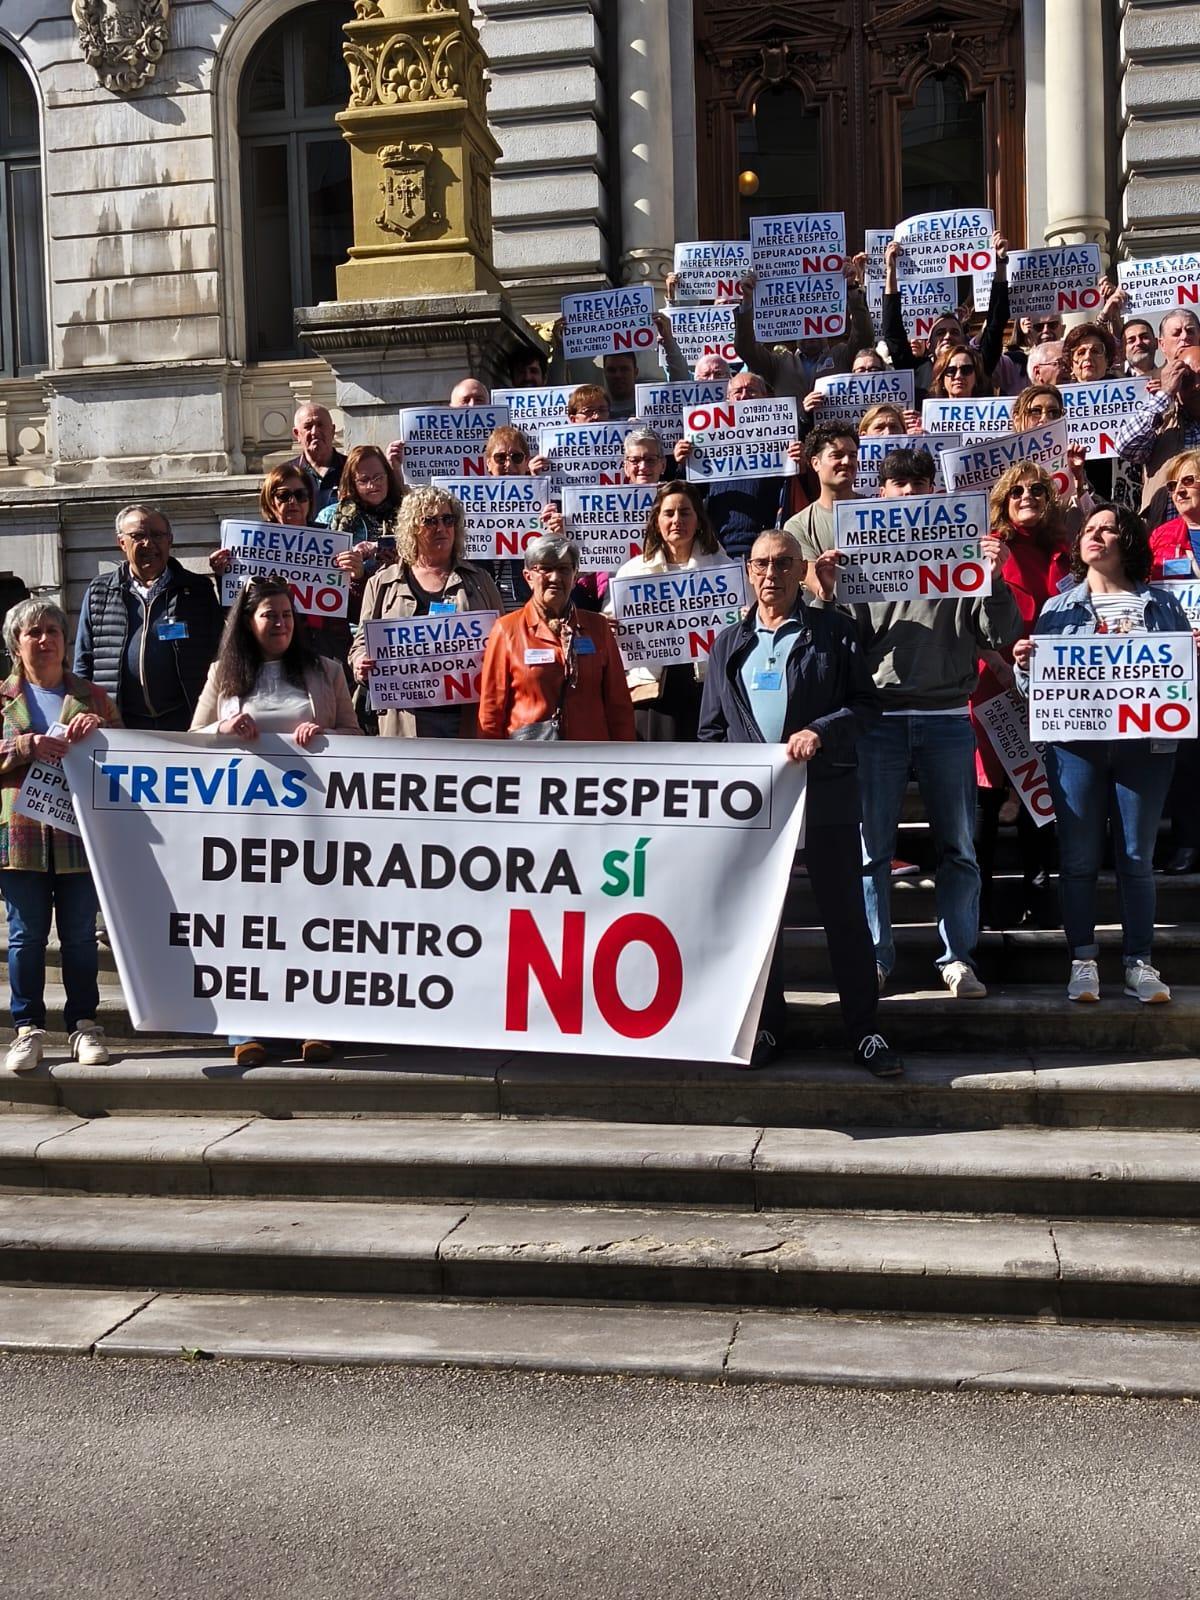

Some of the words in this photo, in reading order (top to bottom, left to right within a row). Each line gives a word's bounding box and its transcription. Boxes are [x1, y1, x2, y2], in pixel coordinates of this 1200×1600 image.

[764, 218, 831, 236] TREVÍAS
[908, 213, 981, 233] TREVÍAS
[758, 235, 795, 246] MERECE
[798, 232, 838, 242] RESPETO
[900, 231, 941, 243] MERECE
[945, 227, 987, 238] RESPETO
[686, 244, 744, 259] TREVÍAS
[753, 247, 825, 260] DEPURADORA
[899, 243, 974, 256] DEPURADORA
[681, 259, 712, 267] MERECE
[715, 258, 749, 266] RESPETO
[802, 255, 843, 273] NO
[919, 258, 946, 266] CENTRO
[950, 252, 991, 273] NO
[1018, 250, 1089, 270] TREVÍAS
[917, 266, 942, 274] PUEBLO
[1012, 269, 1049, 281] MERECE
[1052, 264, 1096, 277] RESPETO
[1126, 267, 1168, 277] MERECE
[766, 277, 833, 296] TREVÍAS
[1145, 289, 1174, 299] CENTRO
[574, 292, 642, 312] TREVÍAS
[760, 294, 796, 306] MERECE
[800, 291, 840, 302] RESPETO
[1019, 297, 1026, 305] EL
[1028, 295, 1054, 303] CENTRO
[1058, 289, 1100, 311] NO
[1144, 298, 1170, 307] PUEBLO
[569, 311, 604, 323] MERECE
[608, 305, 648, 318] RESPETO
[756, 305, 827, 319] DEPURADORA
[1026, 303, 1051, 312] PUEBLO
[564, 321, 635, 336] DEPURADORA
[804, 315, 843, 336] NO
[585, 336, 611, 344] CENTRO
[613, 328, 653, 350] NO
[584, 343, 608, 352] PUEBLO
[827, 376, 900, 395] TREVÍAS
[650, 385, 724, 404] TREVÍAS
[863, 392, 907, 403] RESPETO
[416, 410, 496, 429] TREVÍAS
[688, 406, 736, 431] NO
[409, 430, 452, 441] MERECE
[708, 425, 795, 441] DEPURADORA
[694, 445, 742, 459] RESPETO
[746, 441, 789, 454] MERECE
[960, 432, 1054, 472] TREVÍAS
[429, 460, 460, 468] CENTRO
[702, 453, 783, 475] TREVÍAS
[412, 469, 424, 477] DEL
[427, 468, 456, 476] PUEBLO
[448, 481, 534, 501] TREVÍAS
[491, 501, 542, 512] RESPETO
[572, 511, 621, 523] MERECE
[856, 501, 968, 530] TREVÍAS
[241, 529, 334, 555] TREVÍAS
[846, 529, 905, 546] MERECE
[911, 524, 978, 541] RESPETO
[231, 546, 281, 561] MERECE
[593, 546, 626, 555] CENTRO
[839, 548, 957, 566] DEPURADORA
[590, 556, 621, 565] PUEBLO
[224, 564, 322, 583] DEPURADORA
[842, 574, 854, 583] EN
[859, 573, 869, 582] EL
[872, 570, 914, 580] CENTRO
[919, 562, 985, 594] NO
[629, 574, 728, 602] TREVÍAS
[848, 585, 866, 595] DEL
[869, 582, 908, 593] PUEBLO
[288, 583, 343, 612] NO
[623, 600, 675, 618] MERECE
[680, 592, 738, 610] RESPETO
[384, 618, 482, 645] TREVÍAS
[617, 614, 722, 636] DEPURADORA
[377, 643, 430, 659] MERECE
[622, 642, 633, 651] EN
[648, 637, 685, 648] CENTRO
[628, 652, 644, 661] DEL
[646, 648, 681, 659] PUEBLO
[1053, 640, 1173, 665] TREVÍAS
[371, 658, 477, 677] DEPURADORA
[1042, 666, 1106, 680] MERECE
[1112, 665, 1184, 679] RESPETO
[375, 683, 387, 692] EN
[390, 682, 399, 691] EL
[402, 679, 440, 689] CENTRO
[381, 693, 398, 701] DEL
[400, 690, 436, 700] PUEBLO
[1033, 687, 1161, 701] DEPURADORA
[1035, 709, 1050, 718] EN
[1053, 709, 1065, 718] EL
[1068, 708, 1113, 718] CENTRO
[1118, 703, 1191, 733] NO
[1042, 721, 1061, 730] DEL
[1064, 720, 1107, 730] PUEBLO
[984, 709, 998, 726] DEL
[994, 726, 1016, 759] PUEBLO
[1006, 724, 1029, 759] CENTRO
[25, 786, 41, 799] EN
[43, 792, 53, 803] EL
[101, 758, 308, 809] TREVÍAS
[325, 771, 521, 815] MERECE
[539, 777, 763, 821] RESPETO
[1012, 758, 1055, 816] NO
[27, 799, 45, 813] DEL
[202, 836, 582, 896] DEPURADORA
[600, 837, 652, 897] SÍ
[169, 912, 226, 948] EN
[242, 915, 287, 951] EL
[302, 917, 483, 959] CENTRO
[505, 907, 684, 1040] NO
[193, 964, 269, 1002] DEL
[285, 968, 455, 1010] PUEBLO
